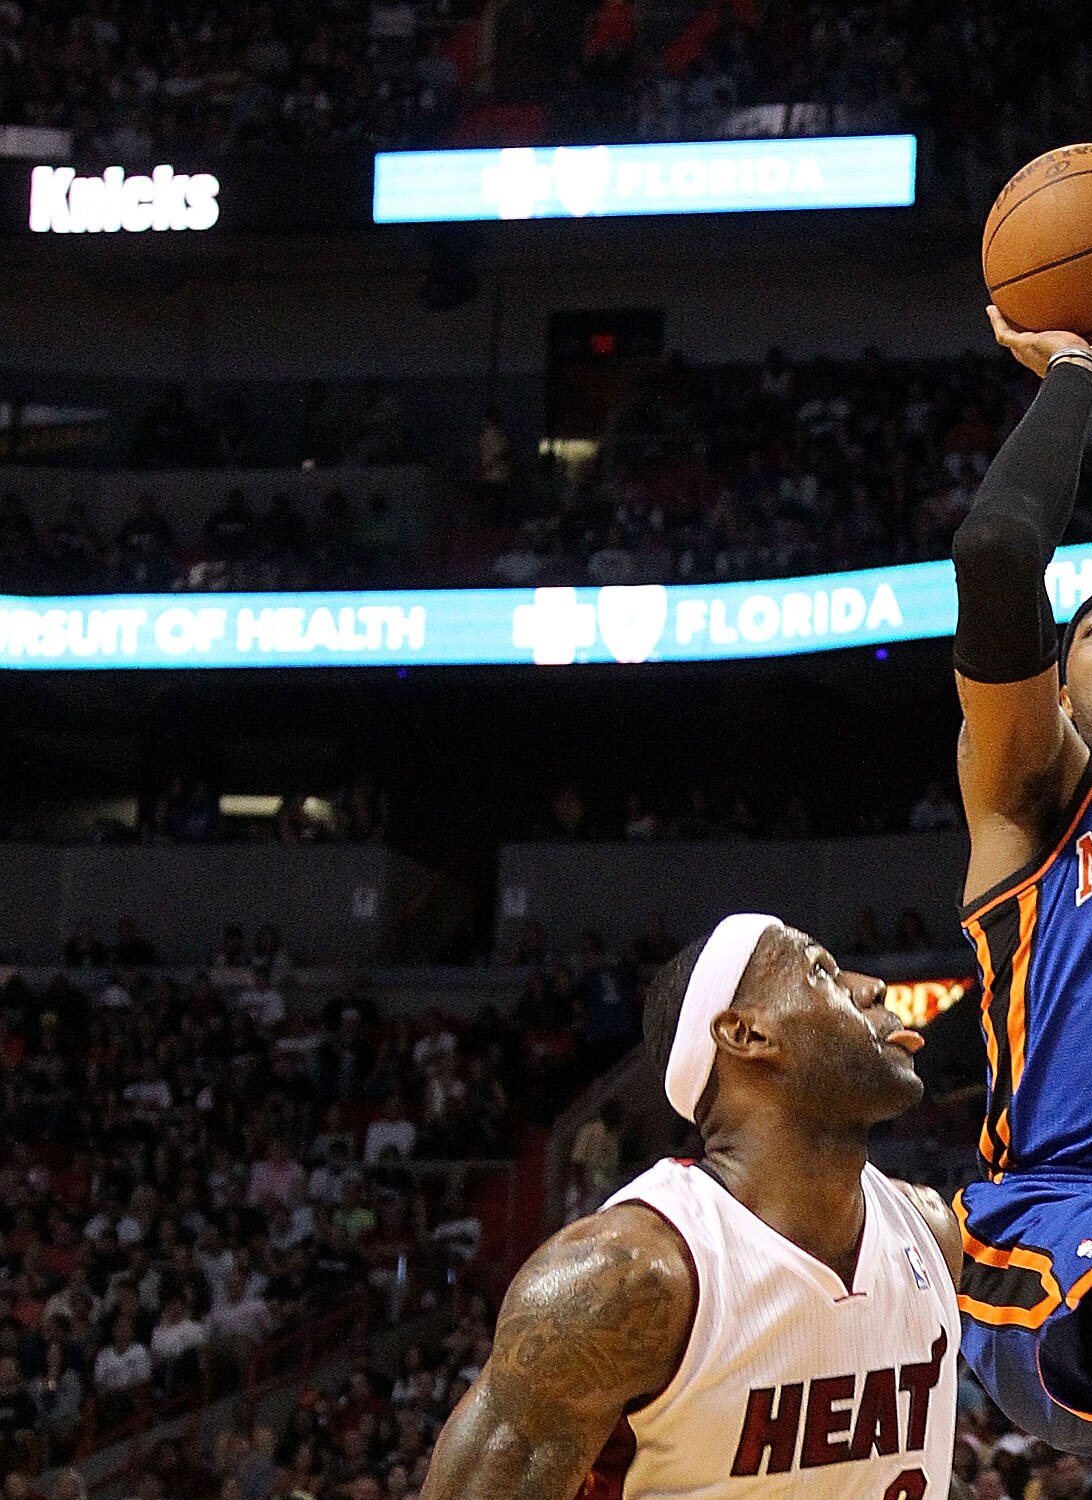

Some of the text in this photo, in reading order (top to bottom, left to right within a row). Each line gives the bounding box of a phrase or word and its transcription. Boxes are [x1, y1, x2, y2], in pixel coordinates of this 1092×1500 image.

[30, 165, 219, 233] Knicks
[616, 157, 825, 198] FLORIDA
[0, 605, 427, 657] RSUIT OF HEALTH
[675, 583, 904, 645] FLORIDA
[730, 1324, 948, 1478] HEAT
